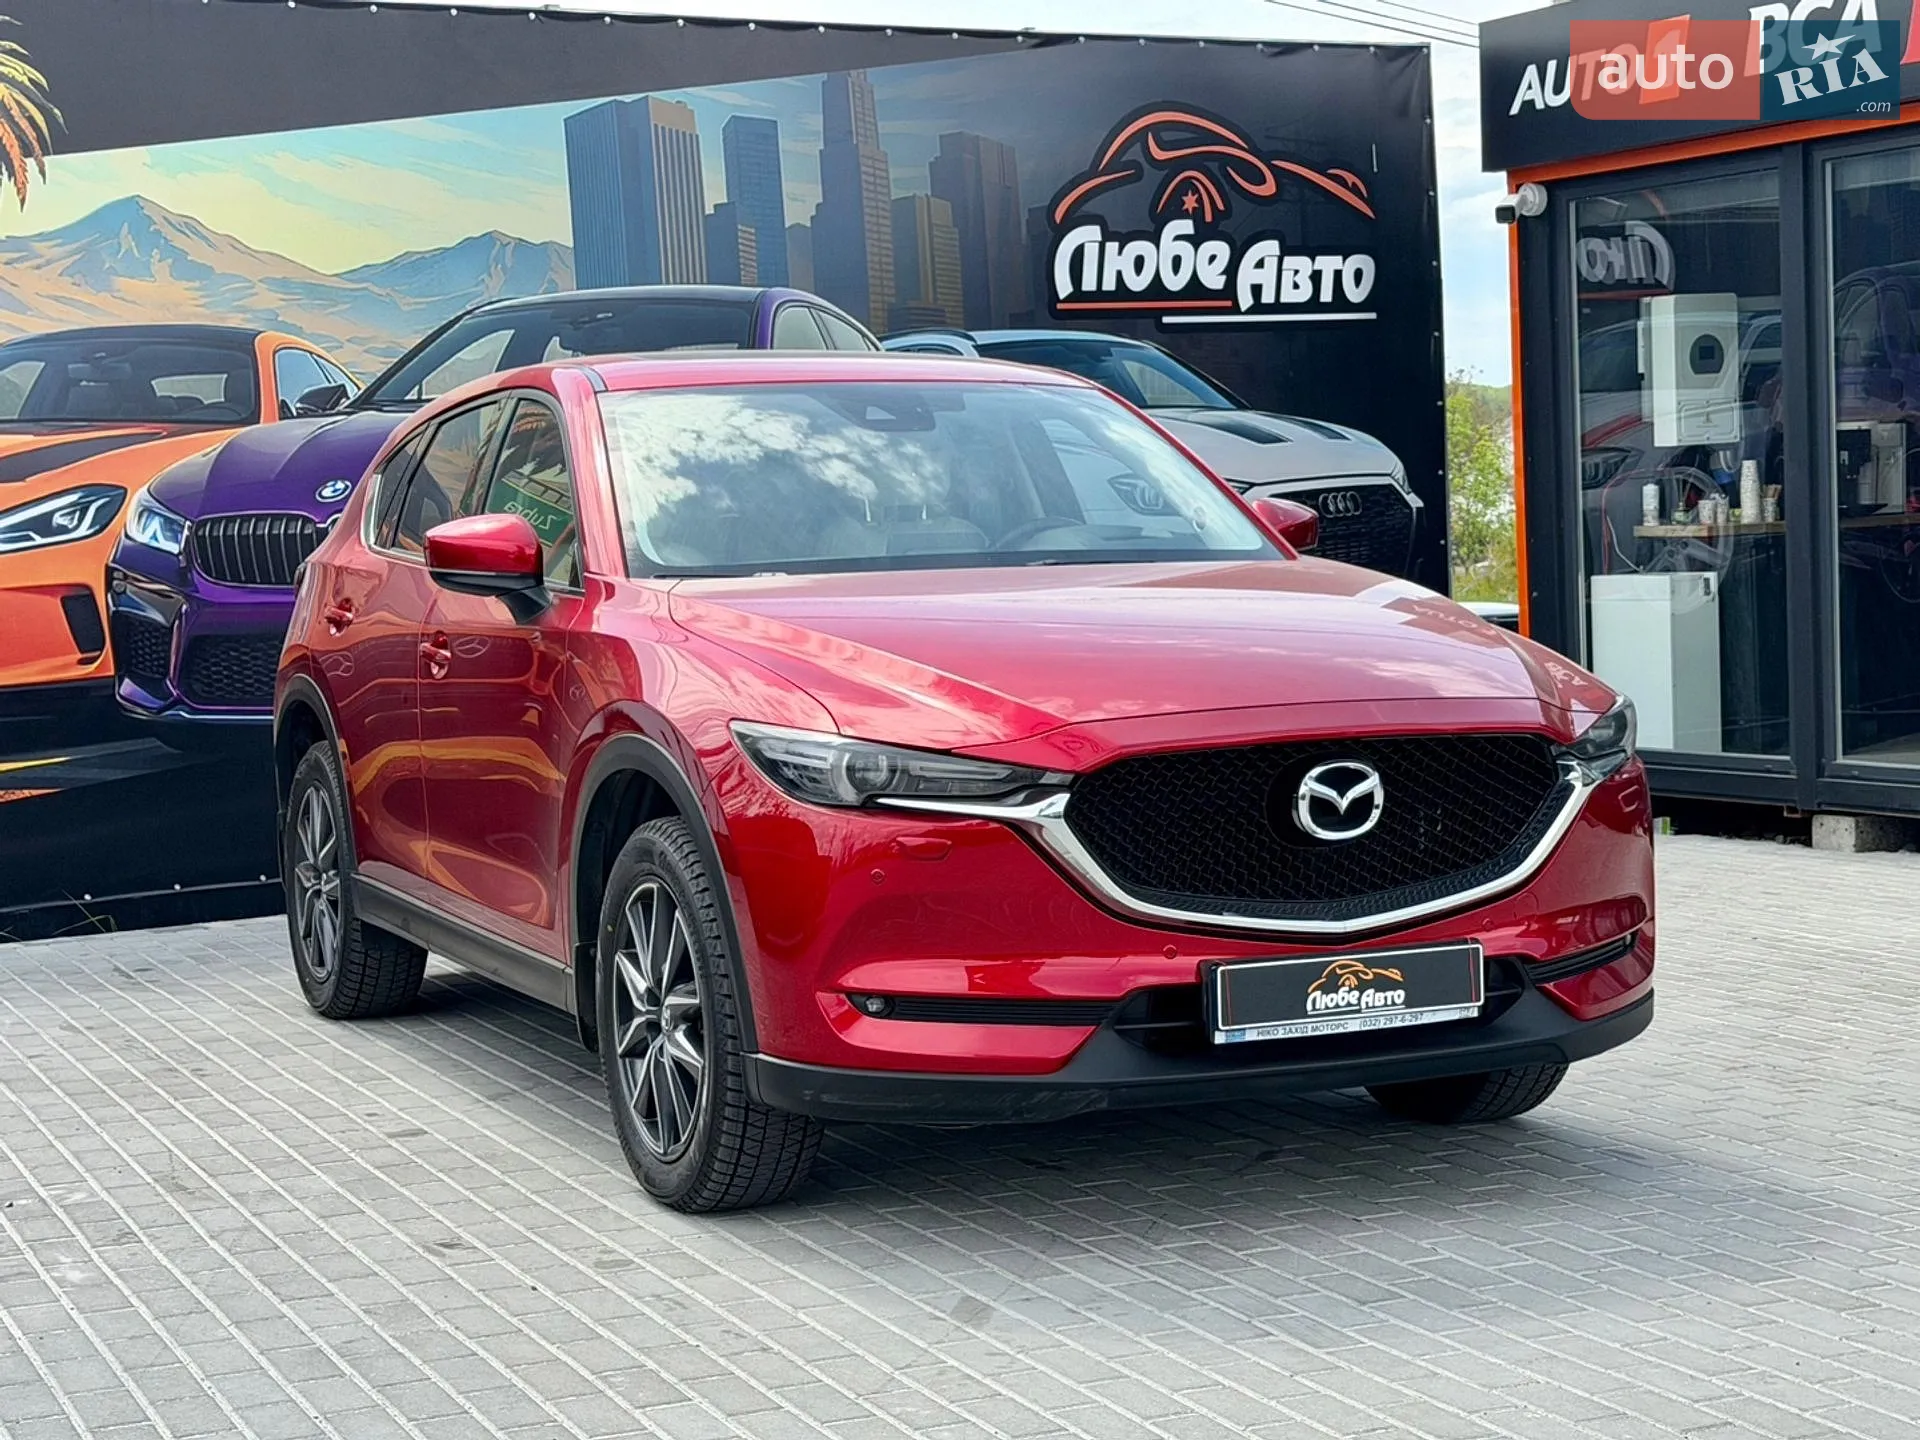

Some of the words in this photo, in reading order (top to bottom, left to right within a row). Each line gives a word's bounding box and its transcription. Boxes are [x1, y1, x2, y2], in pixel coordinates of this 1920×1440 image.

[1054, 219, 1231, 299] Любе
[1236, 240, 1376, 312] Авто
[1306, 986, 1360, 1012] Любе
[1361, 988, 1406, 1010] Авто
[1310, 1022, 1349, 1034] МОТОРС
[1360, 1016, 1381, 1029] (032)
[1382, 1012, 1424, 1026] 297-6-297
